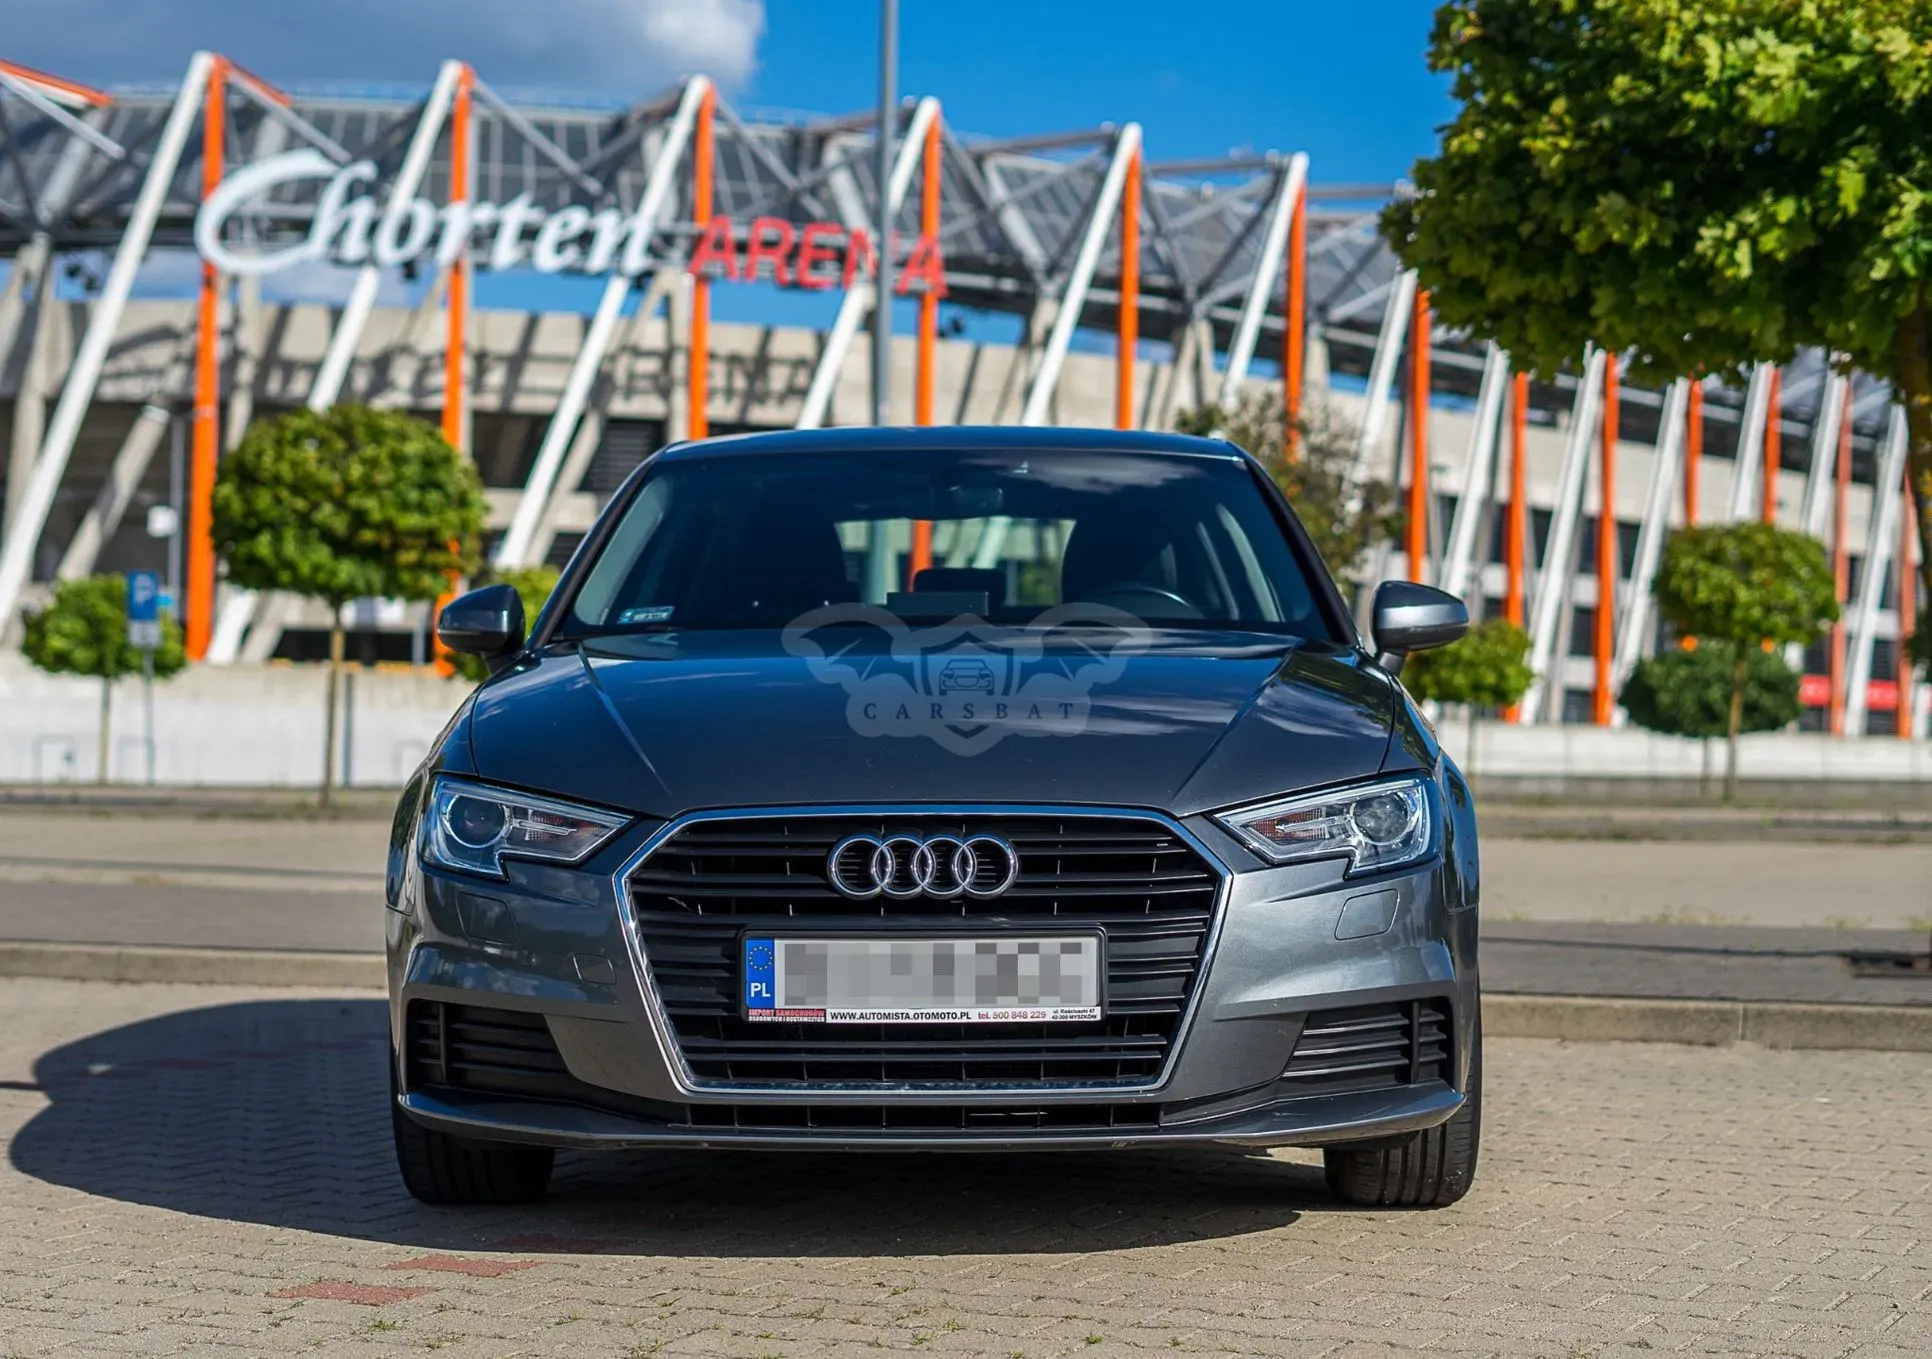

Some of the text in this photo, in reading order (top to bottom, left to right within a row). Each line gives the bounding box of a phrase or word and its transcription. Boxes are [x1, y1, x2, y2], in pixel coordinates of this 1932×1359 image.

[195, 147, 948, 298] Chorten ARENA
[750, 982, 771, 998] PL
[830, 1011, 1047, 1020] WWW.AUTOMISTA.OTOMOTO.PL tel. 500 848 229
